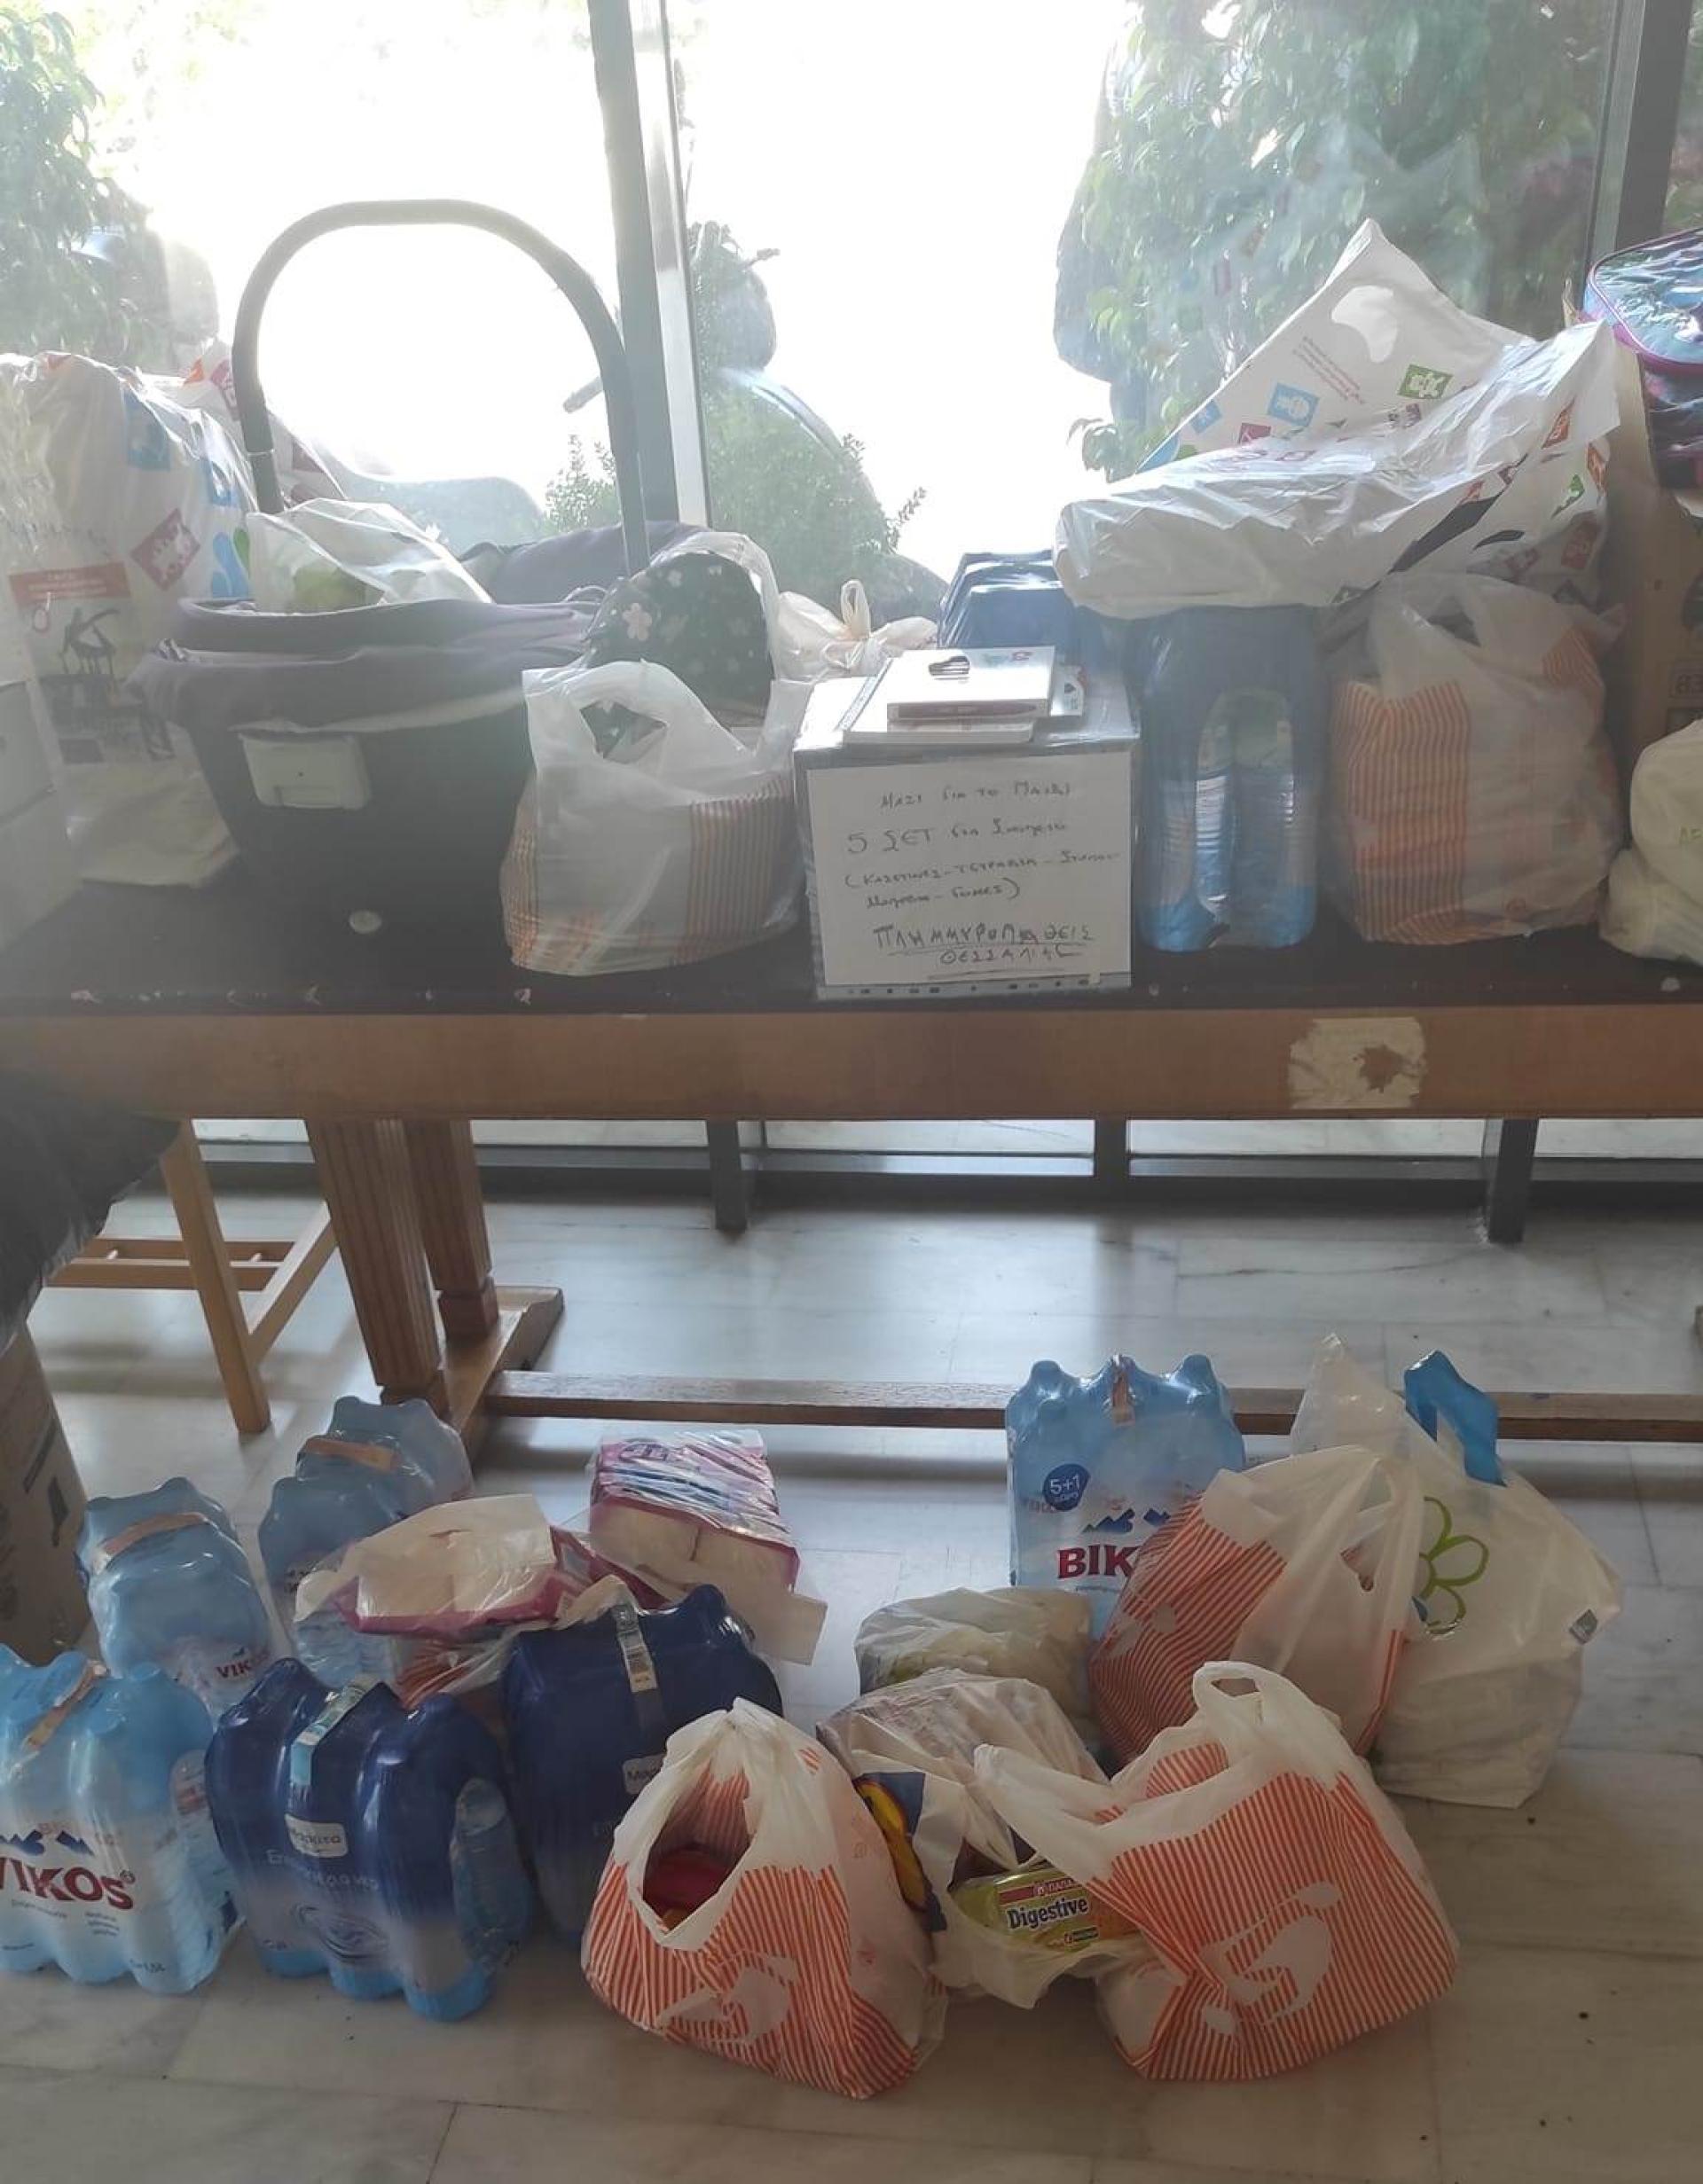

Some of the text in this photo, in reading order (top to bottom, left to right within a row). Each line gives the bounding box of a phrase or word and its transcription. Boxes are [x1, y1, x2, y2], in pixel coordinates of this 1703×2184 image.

[847, 832, 868, 853] 5
[1049, 1474, 1080, 1496] 5+1
[1057, 1543, 1142, 1580] ΒΙΚ
[1007, 1898, 1088, 1930] Digestive
